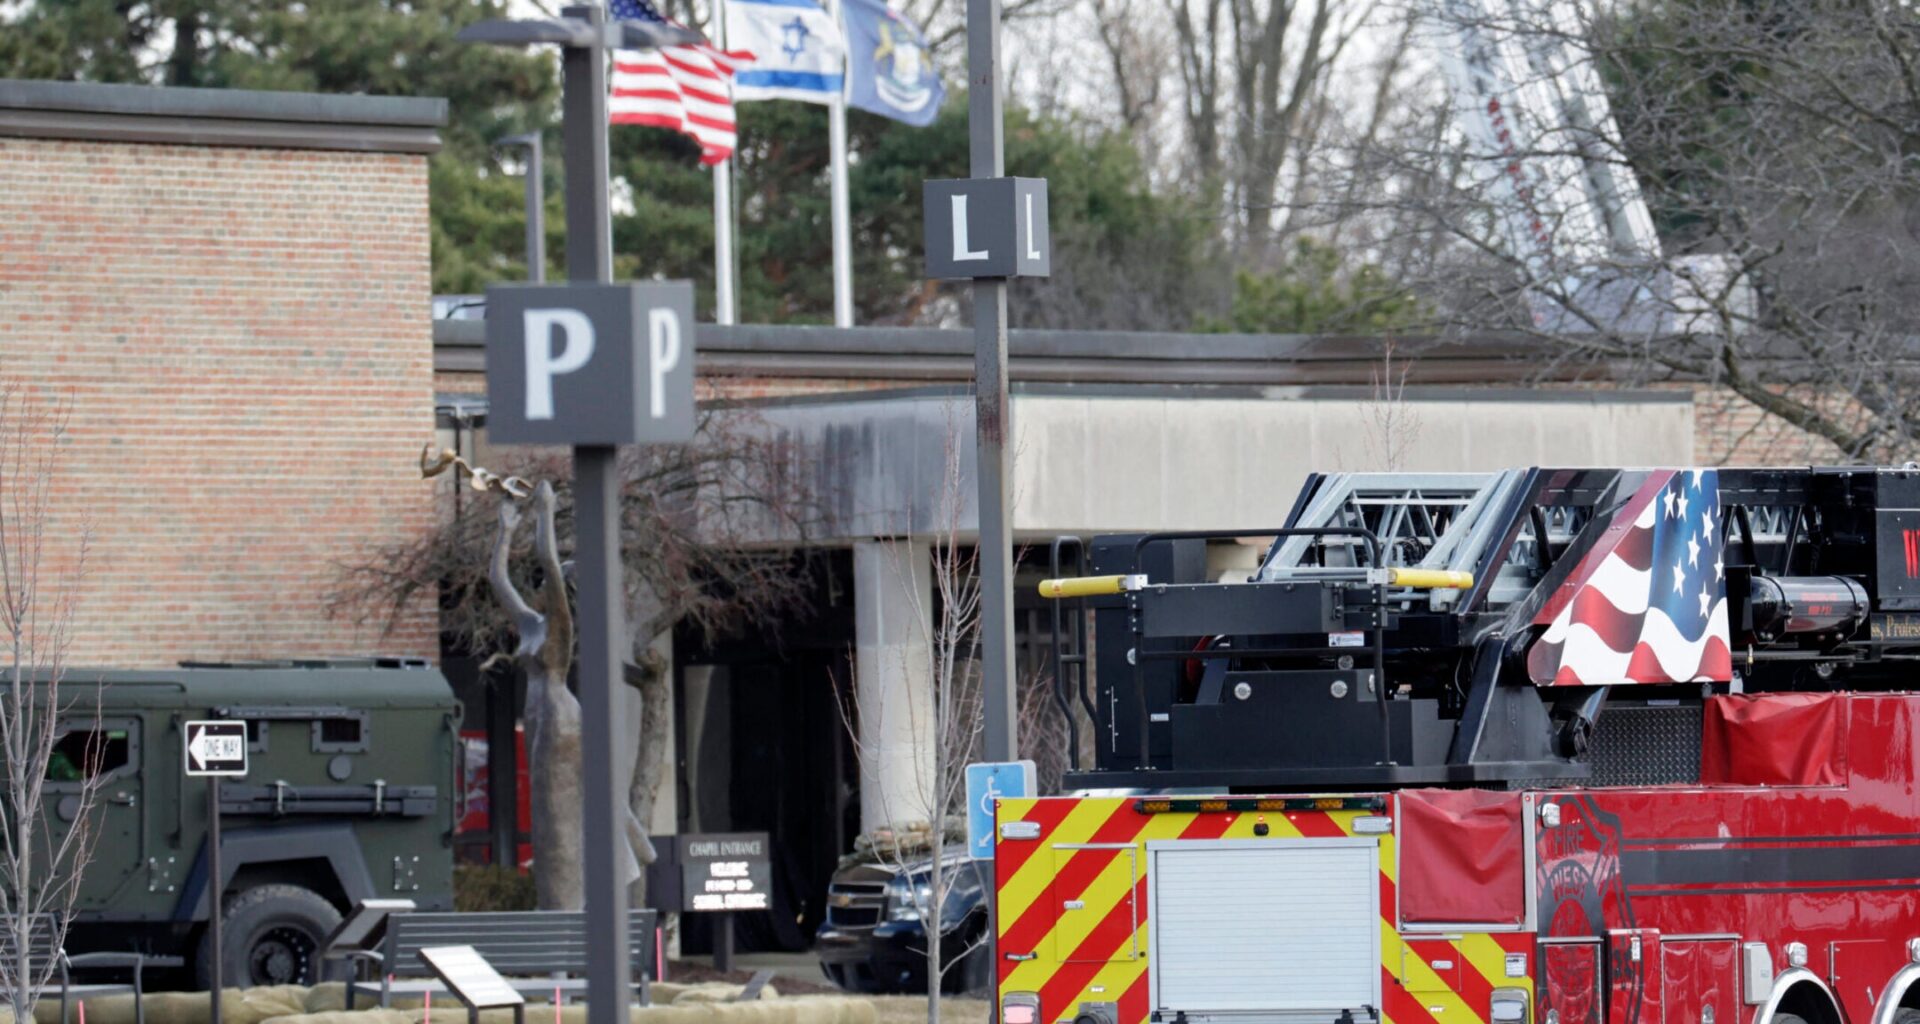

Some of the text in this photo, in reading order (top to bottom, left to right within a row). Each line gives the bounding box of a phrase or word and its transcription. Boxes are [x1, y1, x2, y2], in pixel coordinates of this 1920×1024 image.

[951, 194, 989, 262] L
[1026, 193, 1041, 260] L
[524, 308, 596, 421] P
[648, 307, 682, 419] P
[204, 738, 239, 757] ONE WAY
[689, 840, 761, 857] CHAPEL ENTRANCE
[1554, 824, 1584, 856] FIRE
[1550, 866, 1588, 901] WEST
